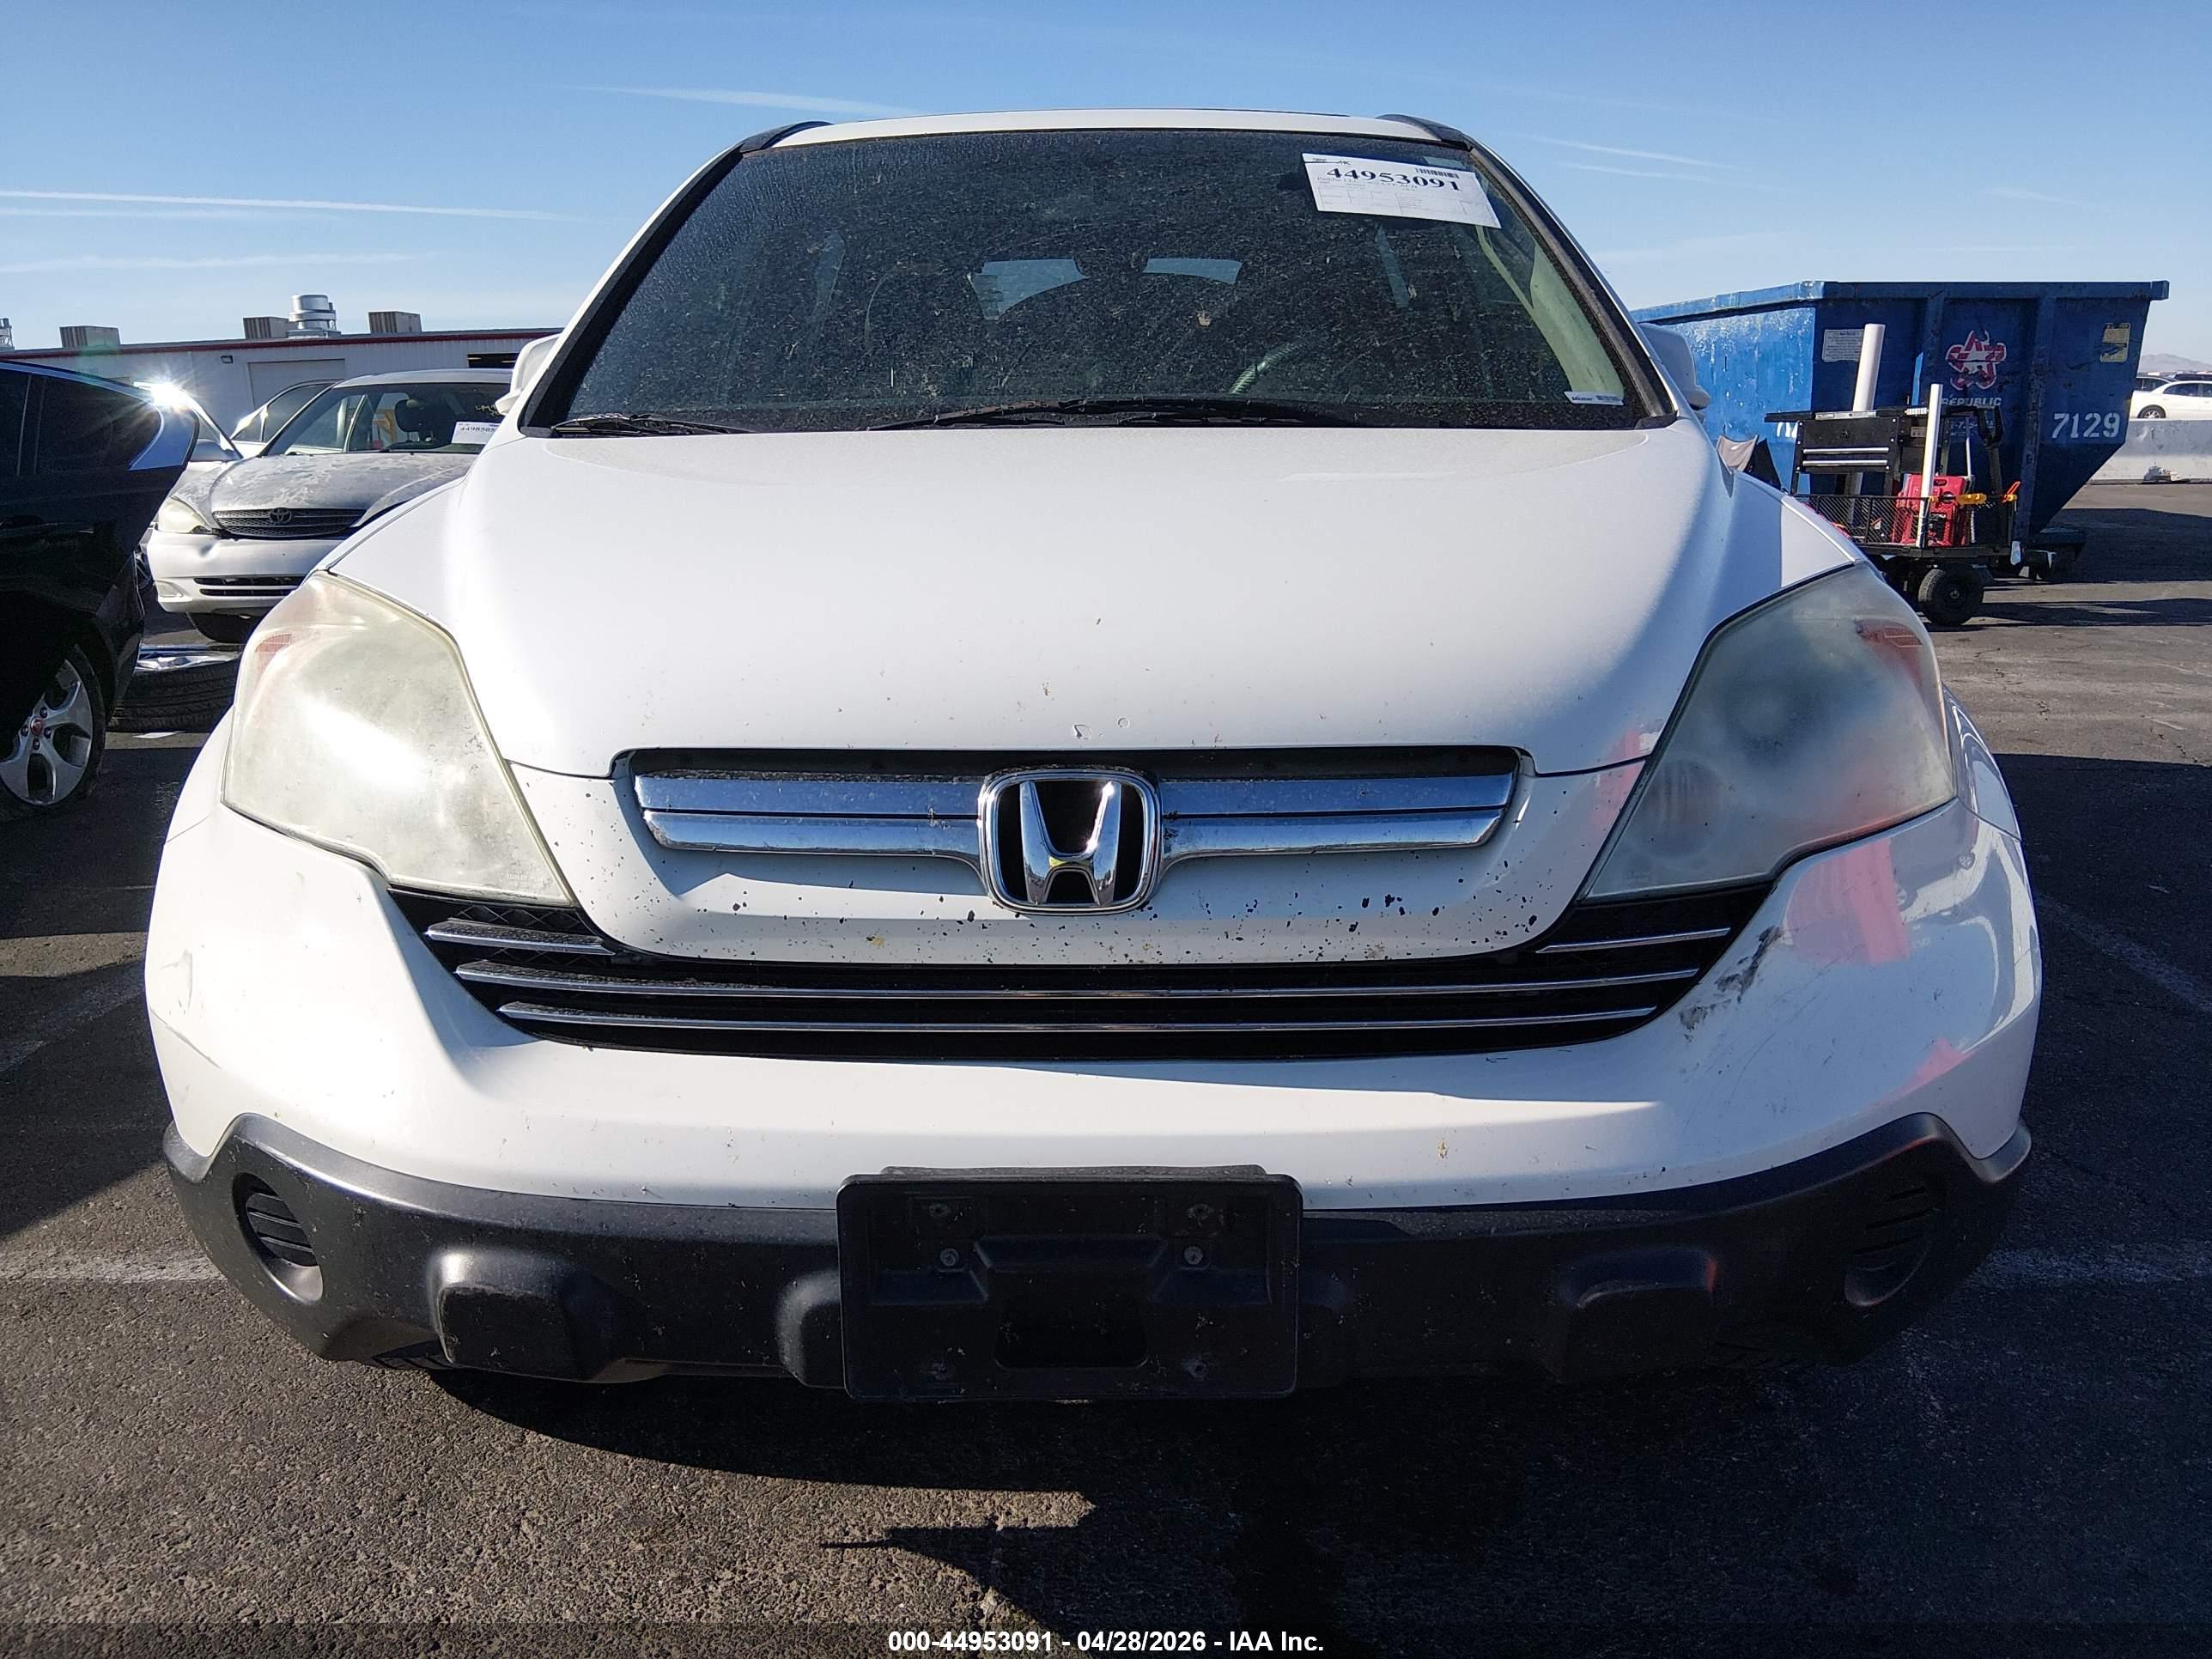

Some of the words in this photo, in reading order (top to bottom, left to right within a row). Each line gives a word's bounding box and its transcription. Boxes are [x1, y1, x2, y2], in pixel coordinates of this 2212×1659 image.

[1327, 167, 1463, 191] 44953091
[1942, 397, 2002, 407] REPUBLIC
[2051, 412, 2121, 439] 7129
